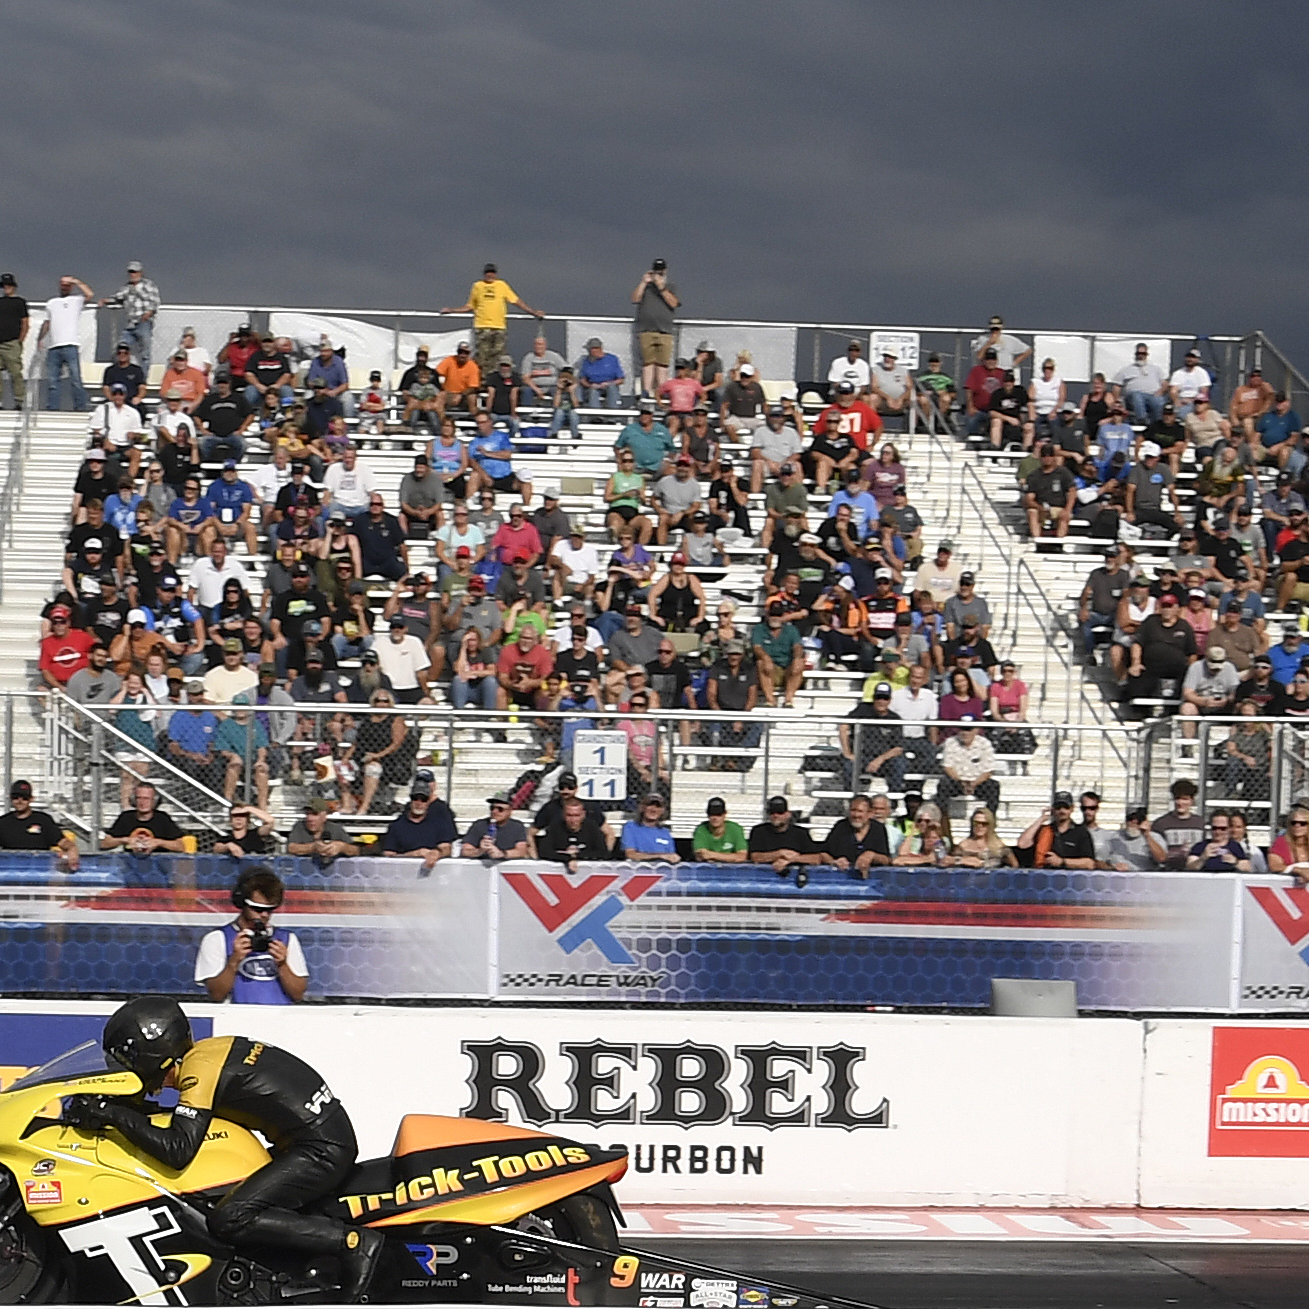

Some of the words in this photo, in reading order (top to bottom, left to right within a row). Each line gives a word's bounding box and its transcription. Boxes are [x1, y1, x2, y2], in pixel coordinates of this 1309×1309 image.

[593, 746, 606, 766] 1
[580, 778, 616, 798] 11
[544, 972, 664, 989] RACEWAY
[460, 1036, 890, 1131] REBEL
[204, 1130, 229, 1140] UKI
[601, 1143, 764, 1175] URBON
[339, 1145, 591, 1219] Trick-Tools
[526, 1273, 566, 1284] transfluid
[610, 1255, 639, 1288] 9
[641, 1273, 685, 1290] WAR
[402, 1279, 430, 1288] REDDY
[432, 1279, 458, 1288] PARTS
